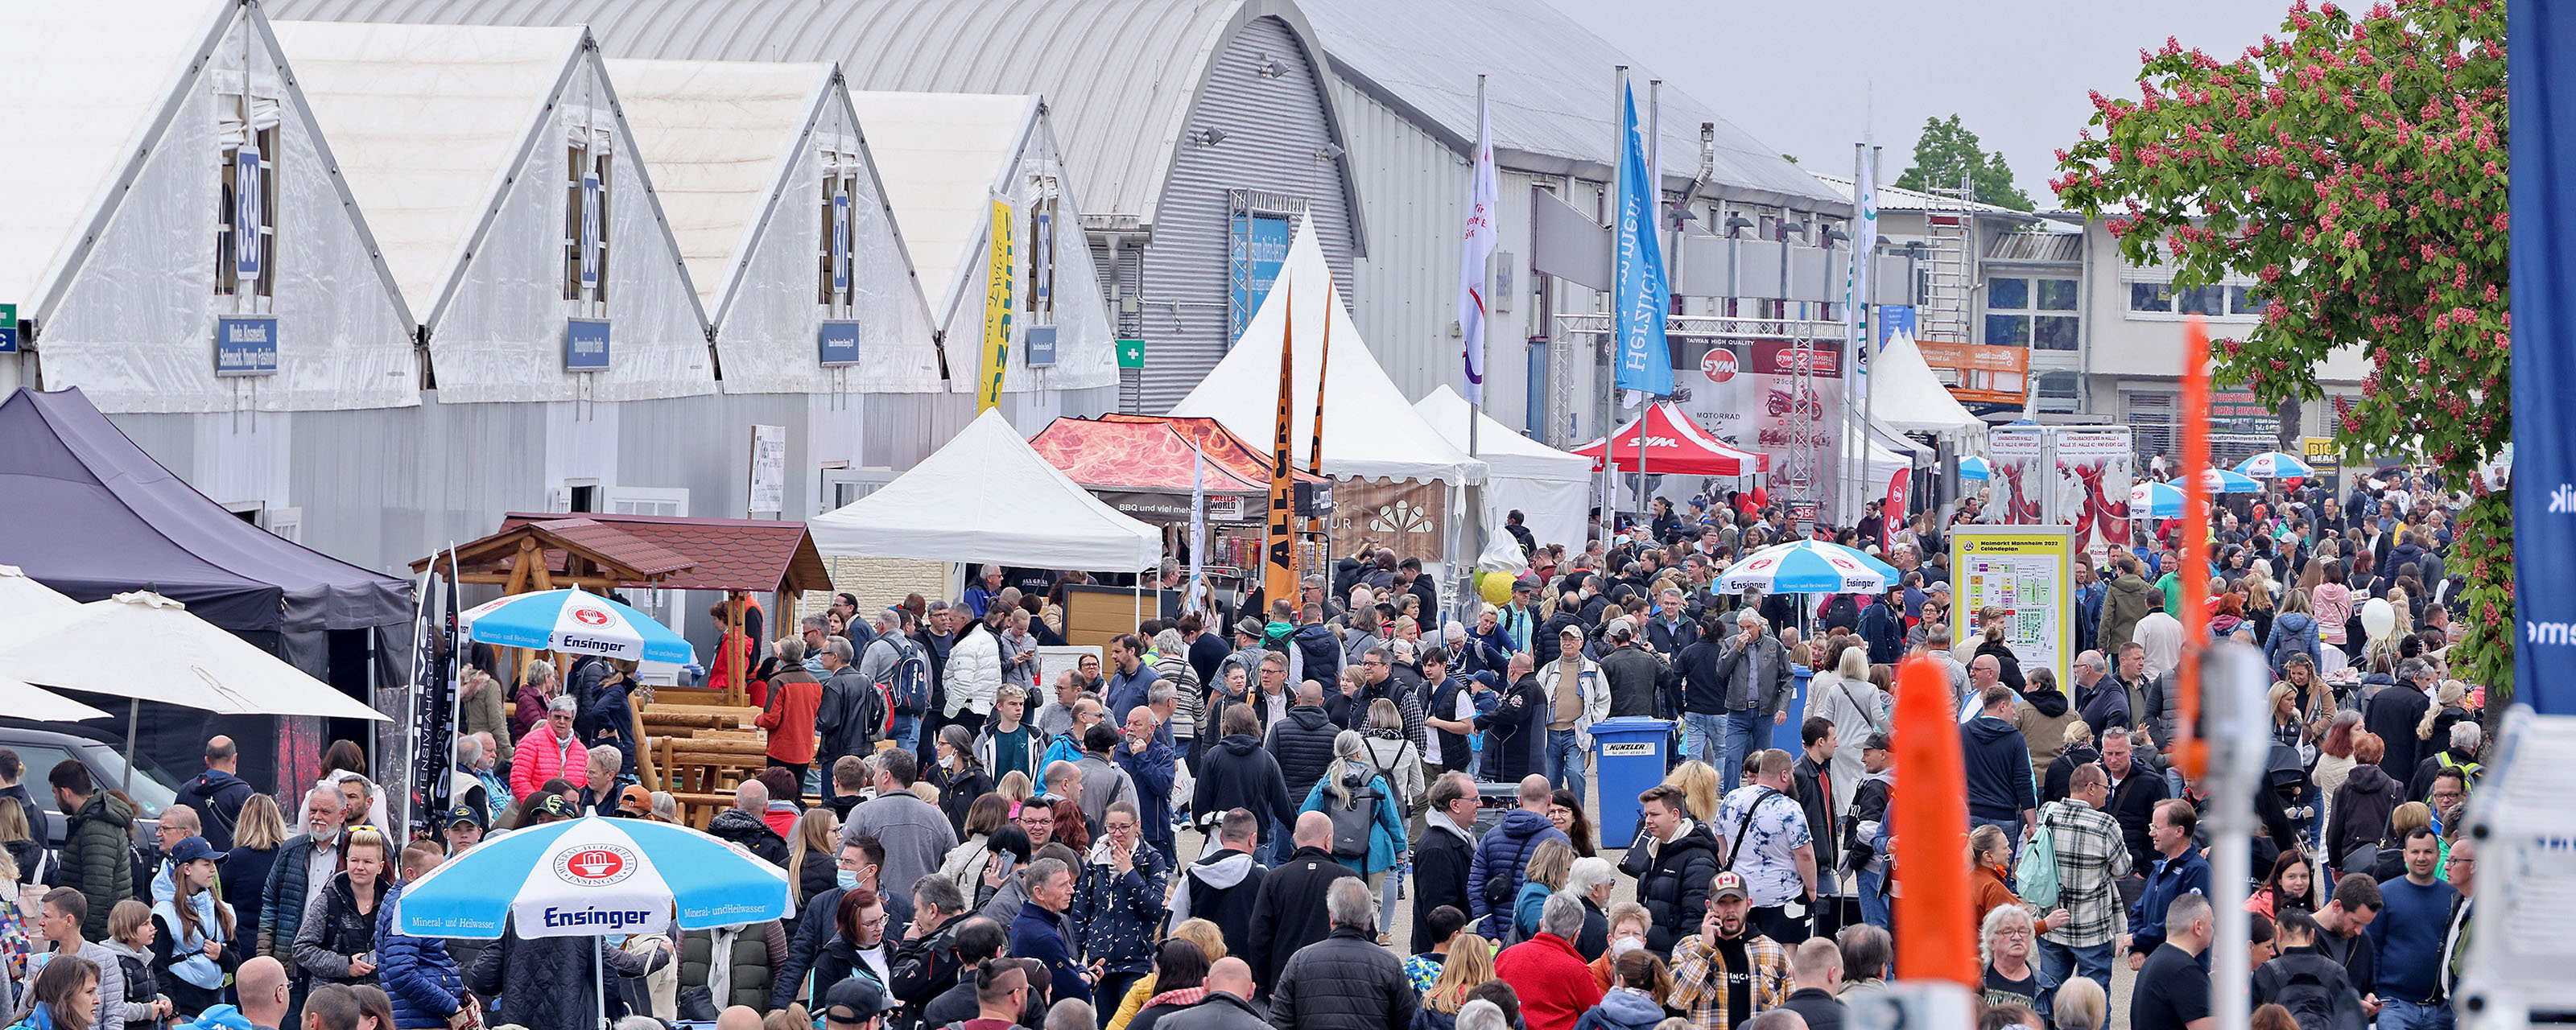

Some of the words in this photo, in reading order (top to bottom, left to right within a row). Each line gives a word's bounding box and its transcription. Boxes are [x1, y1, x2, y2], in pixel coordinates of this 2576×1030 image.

[239, 163, 258, 263] 39
[584, 187, 597, 274] 38
[835, 204, 848, 280] 37
[1039, 221, 1049, 289] 36
[1702, 360, 1739, 377] SYM
[1696, 412, 1740, 420] MOTORRAD
[2213, 406, 2235, 416] HANS
[1627, 435, 1679, 448] SYM
[2309, 443, 2331, 455] BIG
[1119, 504, 1137, 512] BBQ
[1158, 505, 1172, 513] viel
[1173, 506, 1191, 514] meh
[1210, 501, 1236, 509] WORLD
[1269, 489, 1290, 571] ALL
[503, 633, 514, 641] und
[564, 636, 625, 653] Ensinger
[568, 873, 624, 885] ENSINGEN
[543, 905, 652, 929] Ensinger
[684, 906, 712, 919] Mineral-
[712, 904, 728, 917] und
[728, 903, 766, 916] Heilwasser
[411, 917, 444, 928] Mineral-
[445, 917, 457, 928] und
[459, 917, 496, 929] Heilwasser
